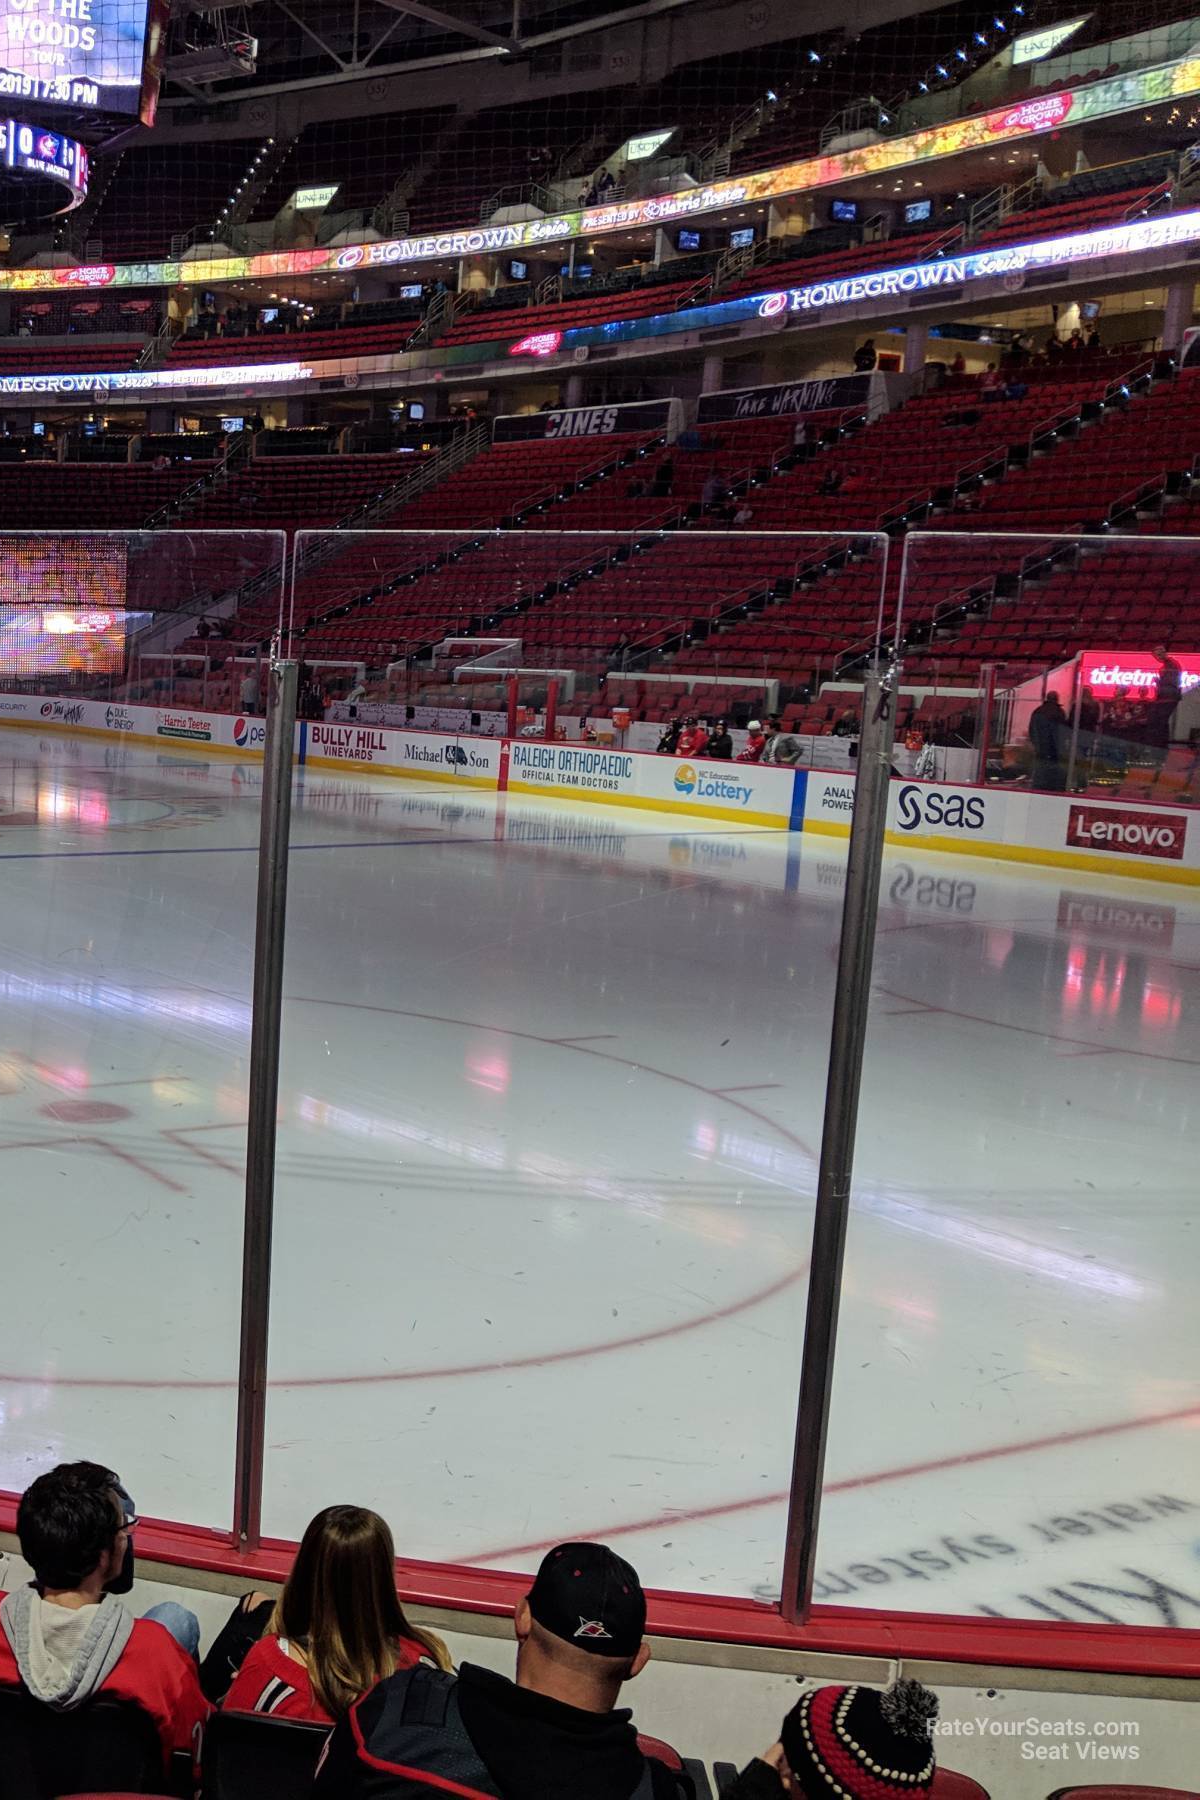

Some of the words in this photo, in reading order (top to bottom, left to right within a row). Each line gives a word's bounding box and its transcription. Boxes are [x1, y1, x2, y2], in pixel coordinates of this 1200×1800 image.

[8, 14, 97, 51] WOODS
[33, 51, 64, 67] TOUR
[41, 79, 70, 100] 7:30
[73, 84, 98, 104] PM
[1020, 107, 1064, 125] GROWN
[1021, 97, 1064, 116] HOME
[19, 128, 33, 154] 0
[46, 162, 70, 179] JACKETS
[583, 212, 627, 228] PRESENTED
[628, 210, 639, 220] BY
[659, 197, 700, 217] Harris
[702, 187, 746, 207] Teeter
[368, 226, 525, 262] HOMEGROWN
[529, 219, 571, 241] Series
[78, 272, 109, 282] GROWN
[79, 267, 108, 275] HOME
[791, 260, 969, 310] HOMEGROWN
[974, 252, 1028, 277] Series
[116, 375, 155, 390] Series
[733, 392, 767, 418] TAKE
[771, 380, 838, 415] WARNING
[544, 407, 618, 438] CANES
[114, 707, 129, 718] DUKE
[114, 719, 135, 731] ENERGY
[164, 714, 186, 728] Harris
[188, 717, 211, 731] Teeter
[311, 726, 353, 745] BULLY
[356, 730, 387, 751] HILL
[323, 745, 374, 761] VINEYARDS
[403, 743, 443, 764] Michael
[469, 752, 490, 769] Son
[513, 745, 555, 770] RALEIGH
[558, 750, 633, 779] ORTHOPAEDIC
[521, 769, 555, 783] OFFICIAL
[556, 773, 579, 786] TEAM
[581, 775, 619, 790] DOCTORS
[699, 770, 709, 779] NC
[709, 772, 740, 782] Education
[697, 779, 753, 806] Lottery
[1075, 814, 1175, 848] Lenovo
[1030, 1493, 1192, 1545] water
